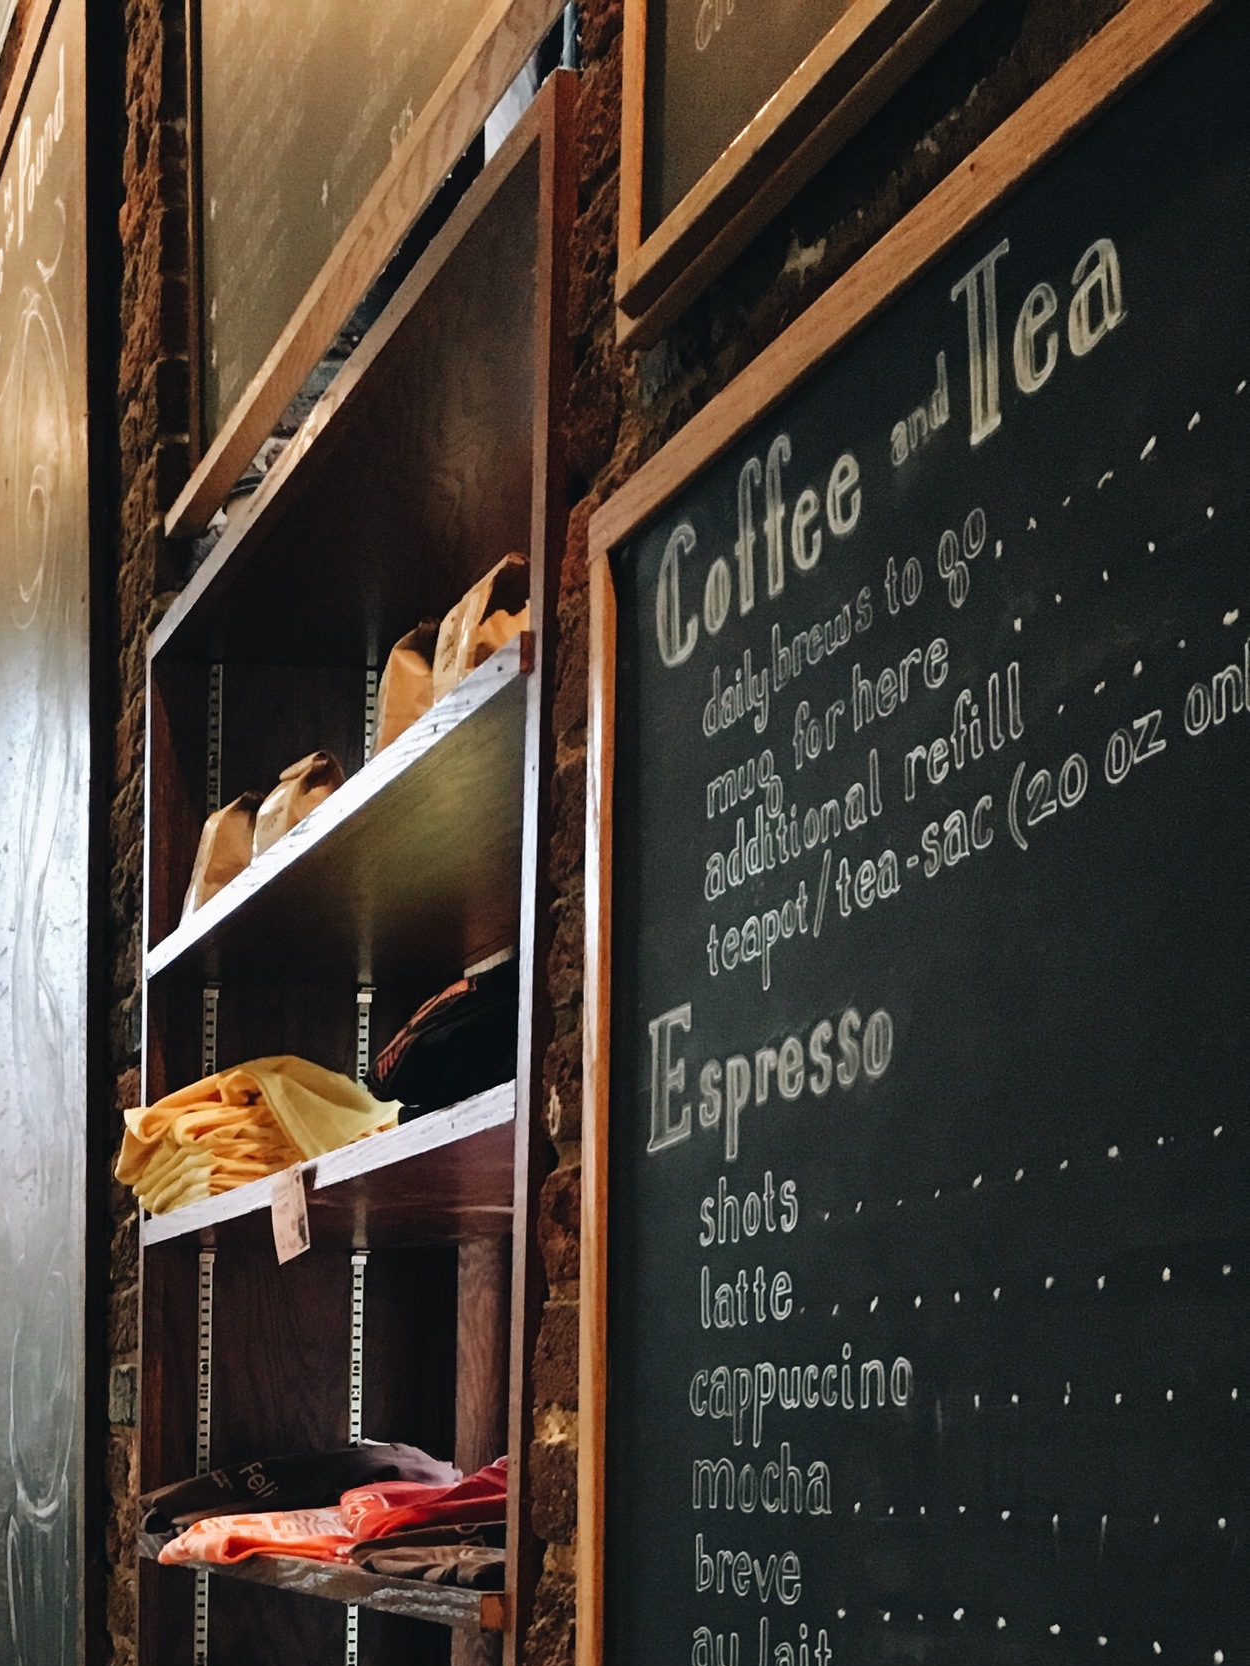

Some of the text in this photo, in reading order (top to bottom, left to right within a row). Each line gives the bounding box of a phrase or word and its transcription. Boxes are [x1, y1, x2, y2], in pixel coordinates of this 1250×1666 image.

[17, 43, 64, 248] Pound
[656, 237, 1126, 668] Coffee and Tea
[703, 507, 987, 737] daily brews to go
[704, 661, 1024, 902] additional refill
[707, 637, 948, 820] mug for here
[1007, 753, 1088, 852] (20
[648, 1003, 894, 1163] Espresso
[698, 1170, 799, 1247] shots
[700, 1264, 793, 1330] latte
[688, 1342, 913, 1449] cappuccino
[692, 1442, 833, 1516] mocha
[695, 1533, 801, 1605] breve
